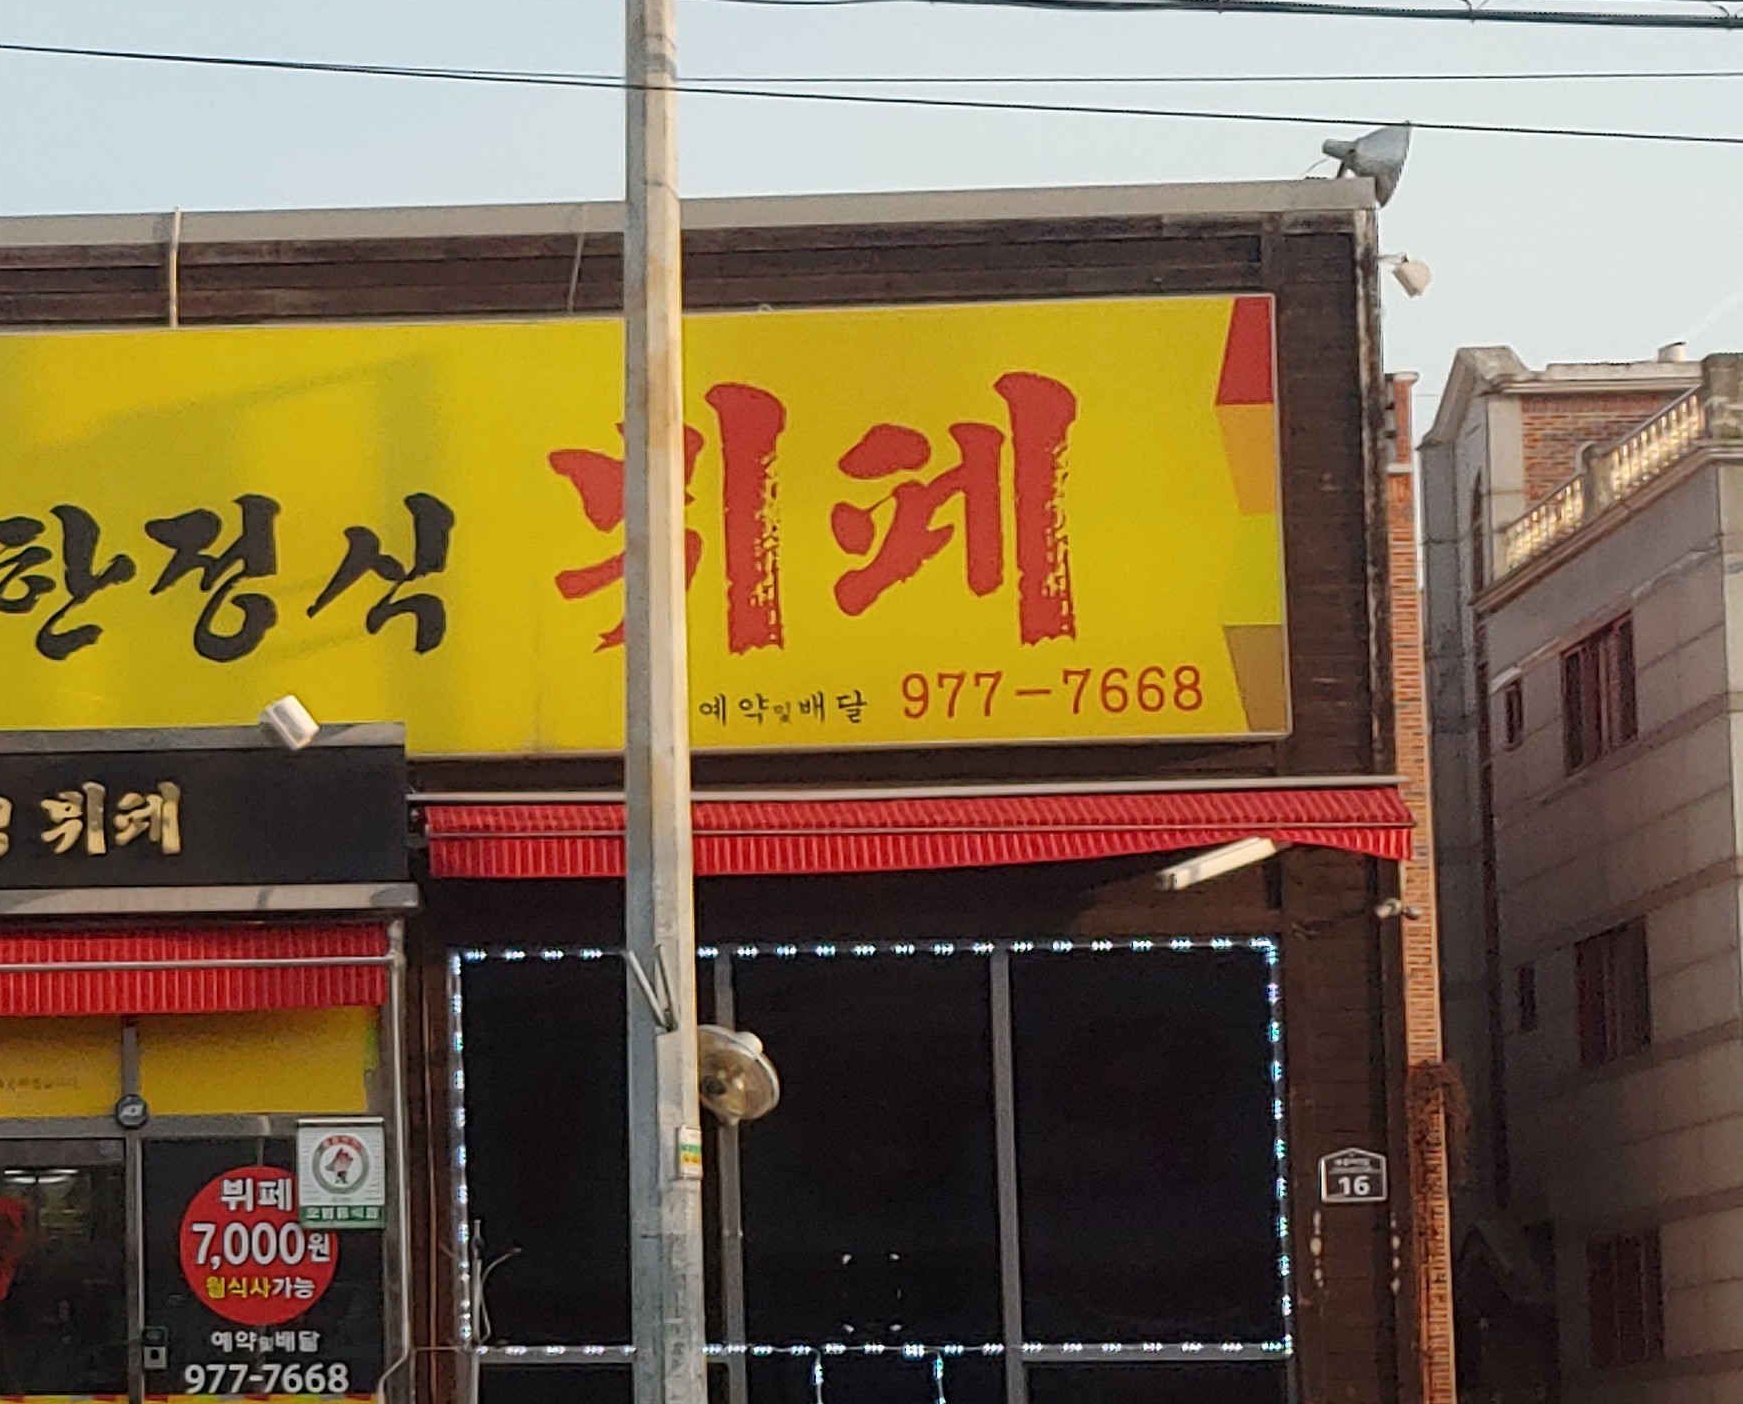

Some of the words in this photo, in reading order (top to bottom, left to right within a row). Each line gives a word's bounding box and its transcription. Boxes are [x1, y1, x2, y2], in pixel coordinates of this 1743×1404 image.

[901, 665, 1204, 720] 977-7668
[221, 1178, 293, 1212] 뷔페
[1337, 1175, 1371, 1196] 16
[184, 1363, 350, 1394] 977-7668
